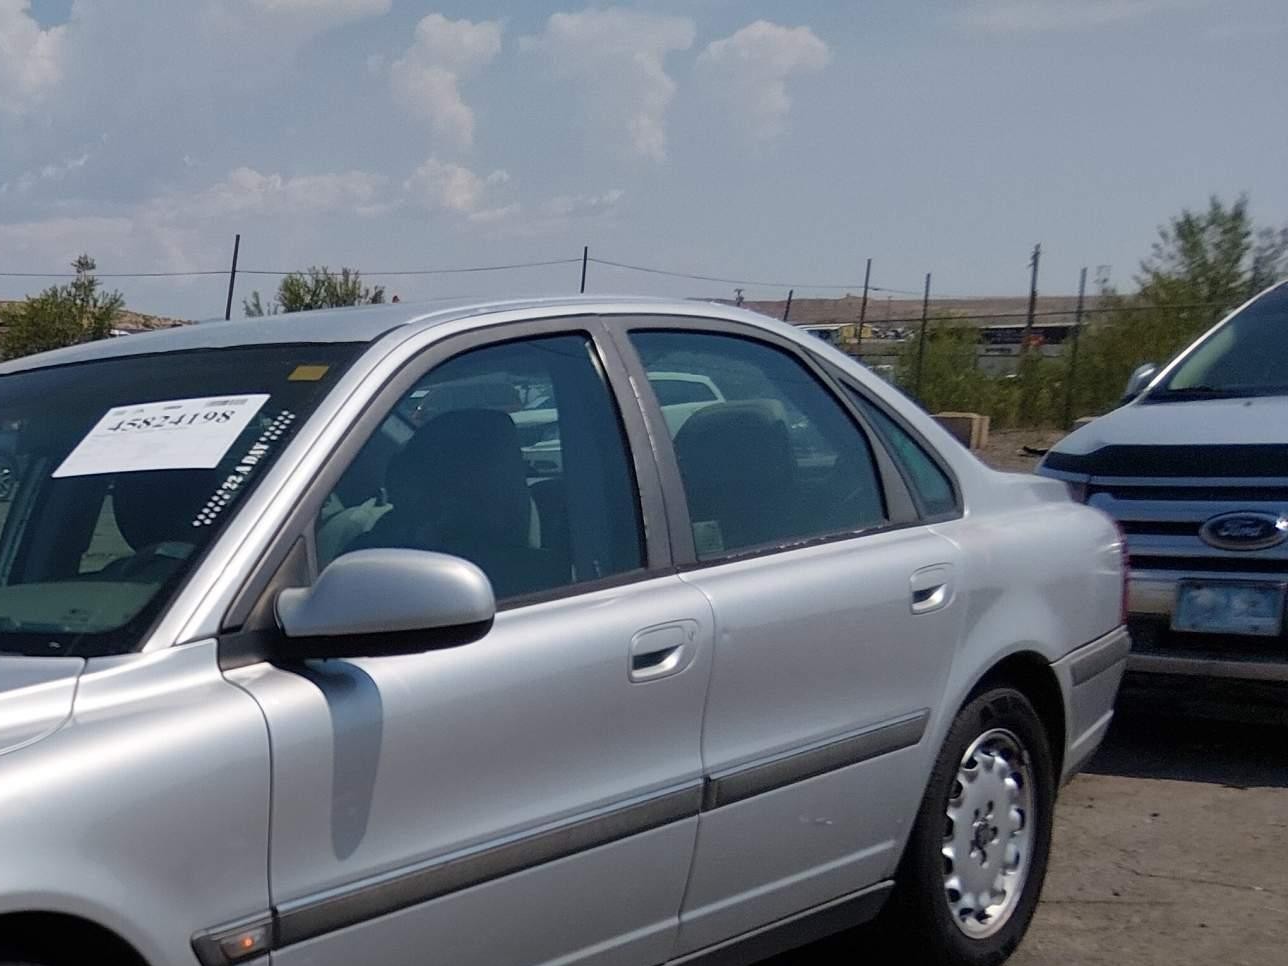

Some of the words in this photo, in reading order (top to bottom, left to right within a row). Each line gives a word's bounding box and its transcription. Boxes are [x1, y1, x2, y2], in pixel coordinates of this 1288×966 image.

[108, 411, 236, 432] 45824198
[222, 475, 244, 490] 22
[242, 442, 270, 465] DAY
